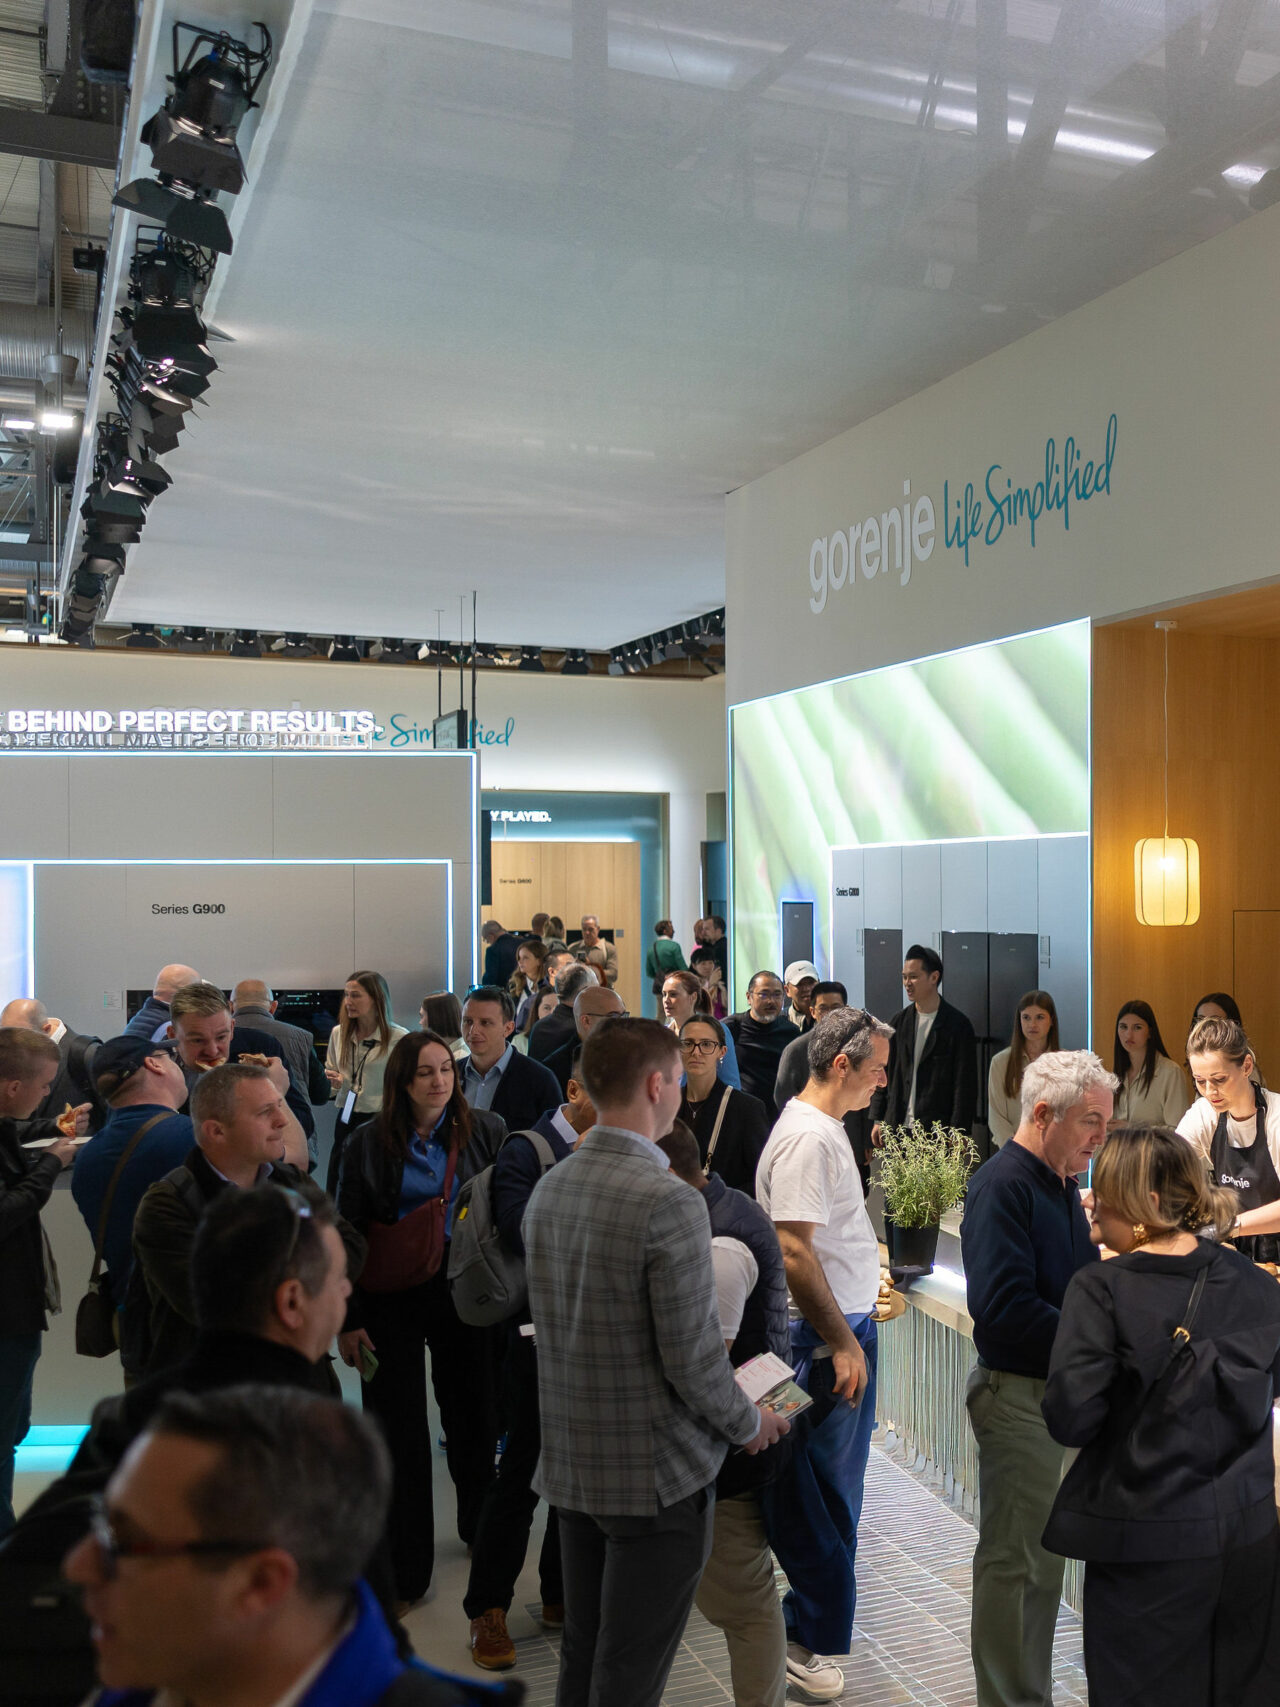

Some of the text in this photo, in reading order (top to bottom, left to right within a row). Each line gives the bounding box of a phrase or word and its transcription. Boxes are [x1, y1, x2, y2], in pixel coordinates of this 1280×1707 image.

[808, 479, 936, 615] gorenje
[985, 413, 1118, 548] Simplified
[8, 710, 113, 732] BEHIND
[119, 710, 245, 732] PERFECT
[250, 710, 384, 733] RESULTS.
[389, 713, 515, 749] Simfied
[151, 903, 226, 915] Series G900
